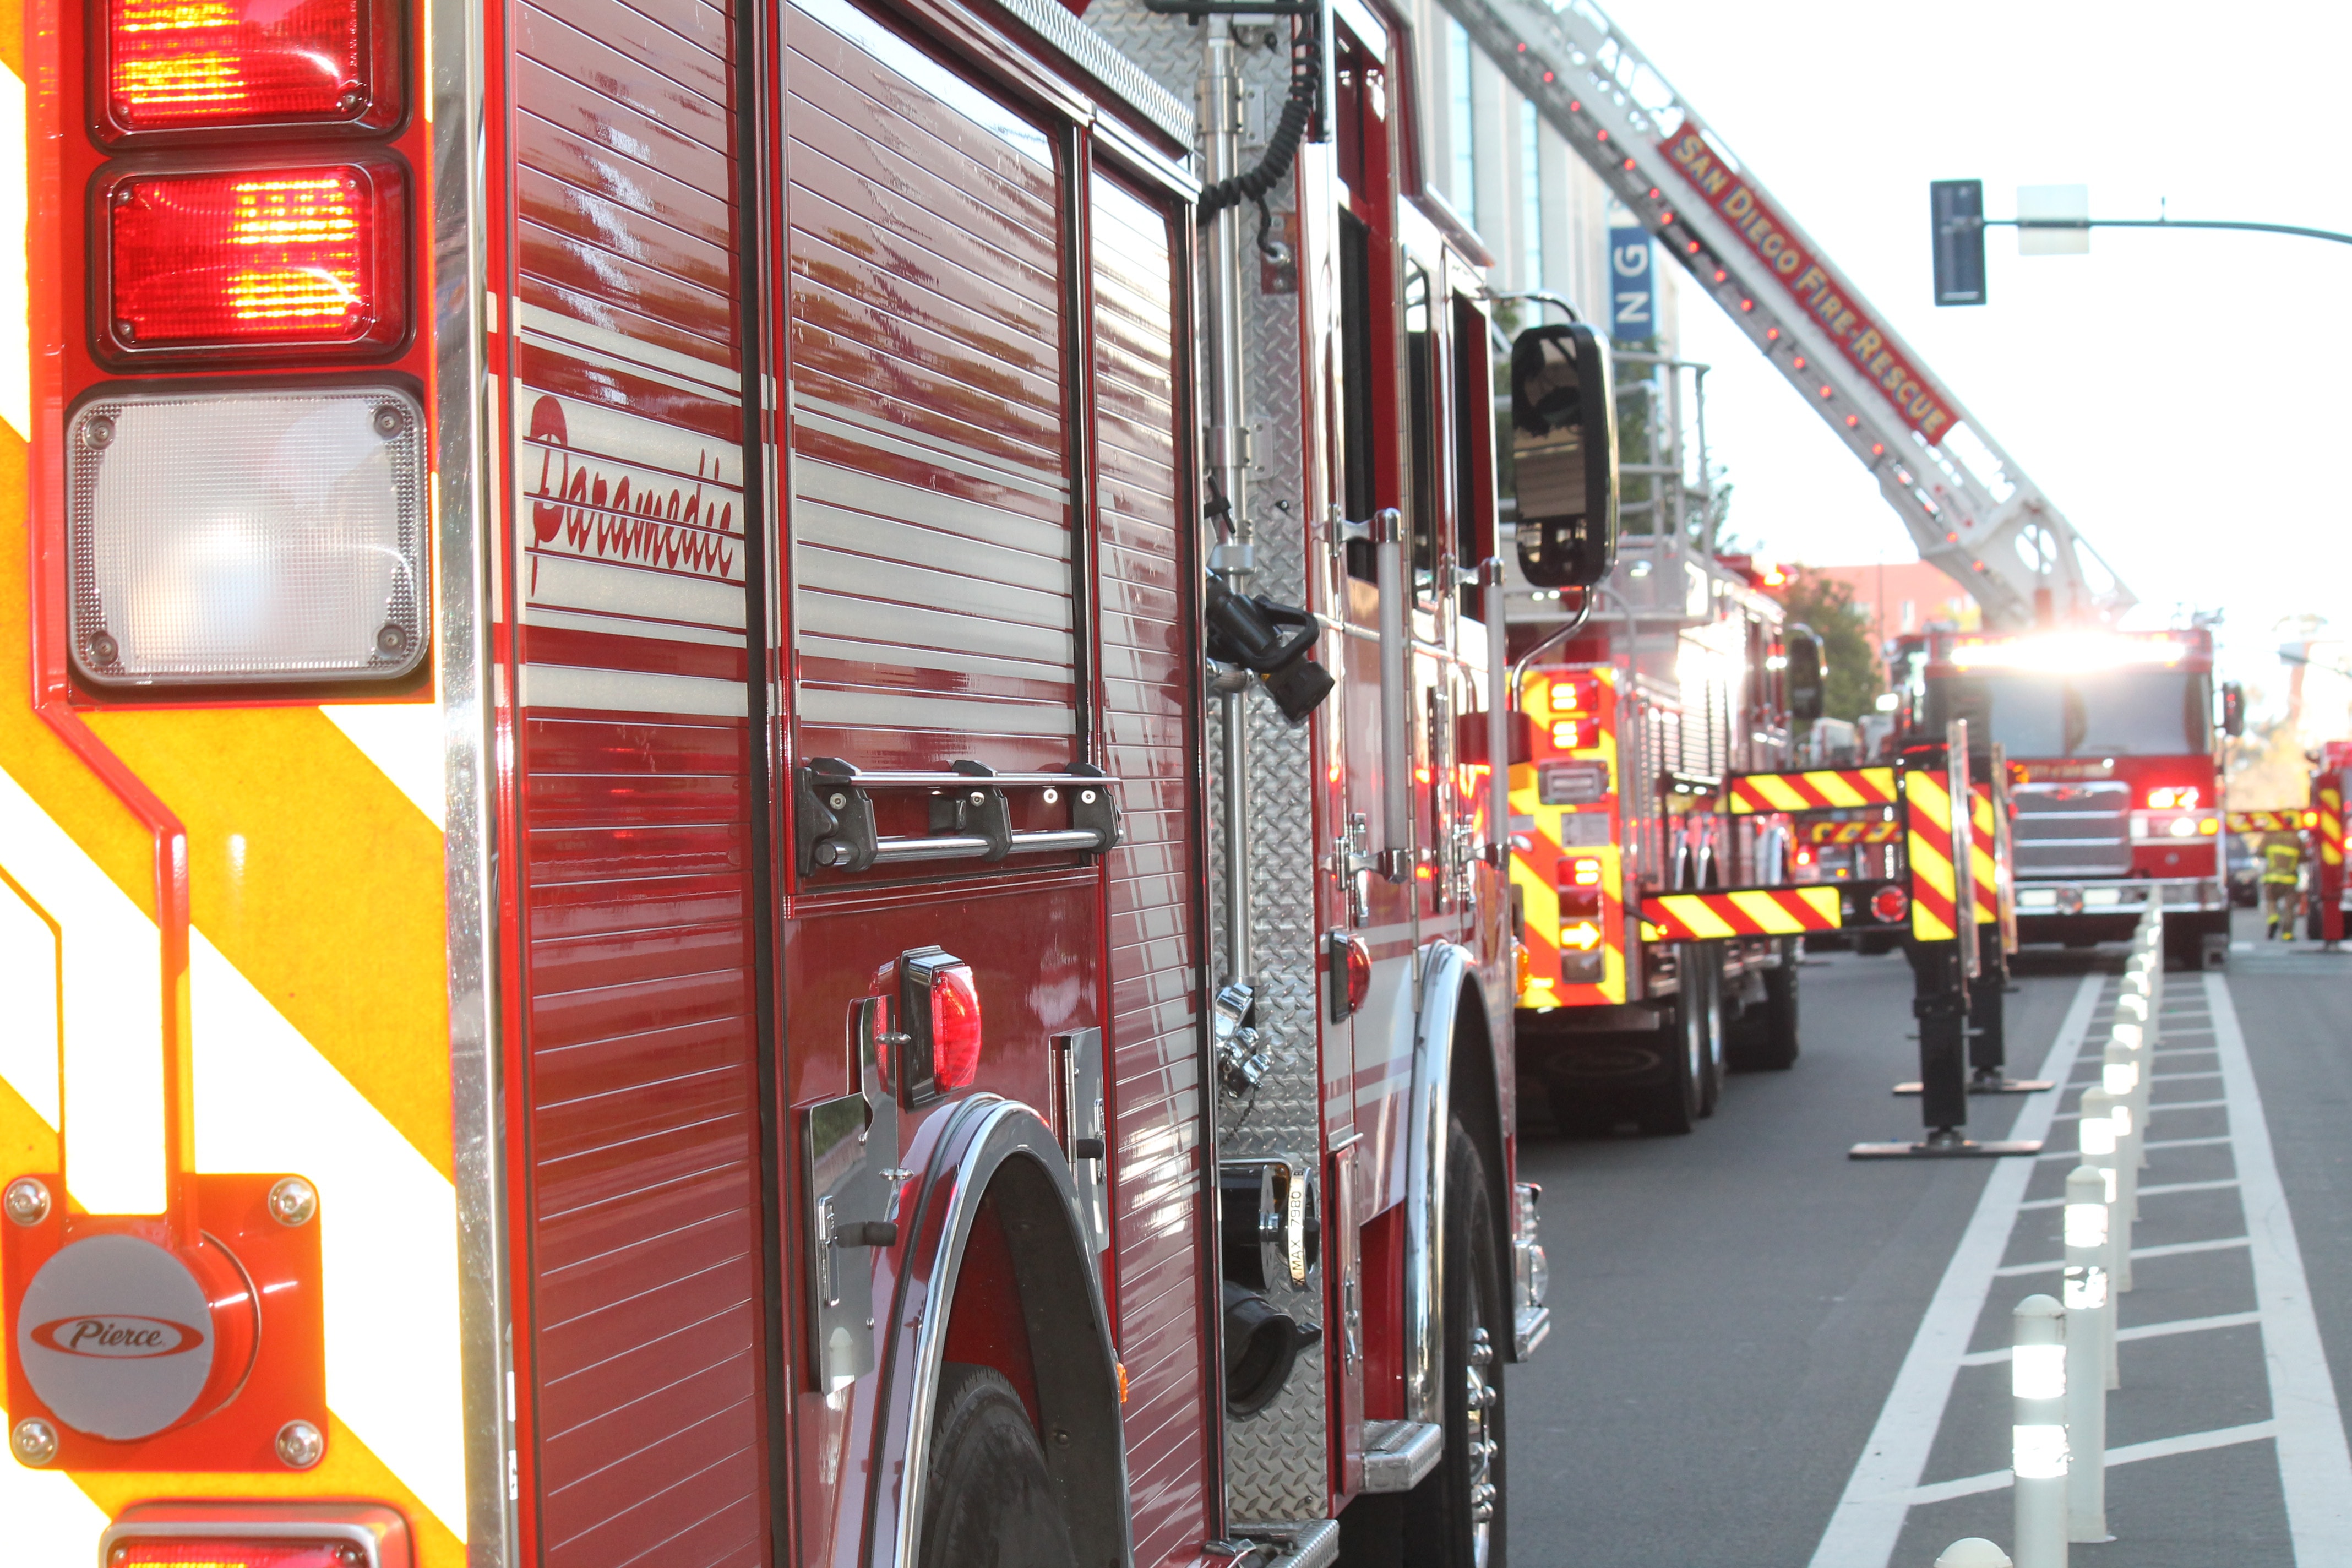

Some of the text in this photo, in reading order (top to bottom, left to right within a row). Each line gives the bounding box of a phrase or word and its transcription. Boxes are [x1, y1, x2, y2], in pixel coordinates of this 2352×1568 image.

[1672, 135, 1728, 193] SAN
[1722, 185, 1799, 274] DIEGO
[530, 395, 733, 598] Paramedic
[1291, 1191, 1302, 1227] 7980
[1292, 1239, 1303, 1270] MAX
[70, 1320, 164, 1351] Pierce
